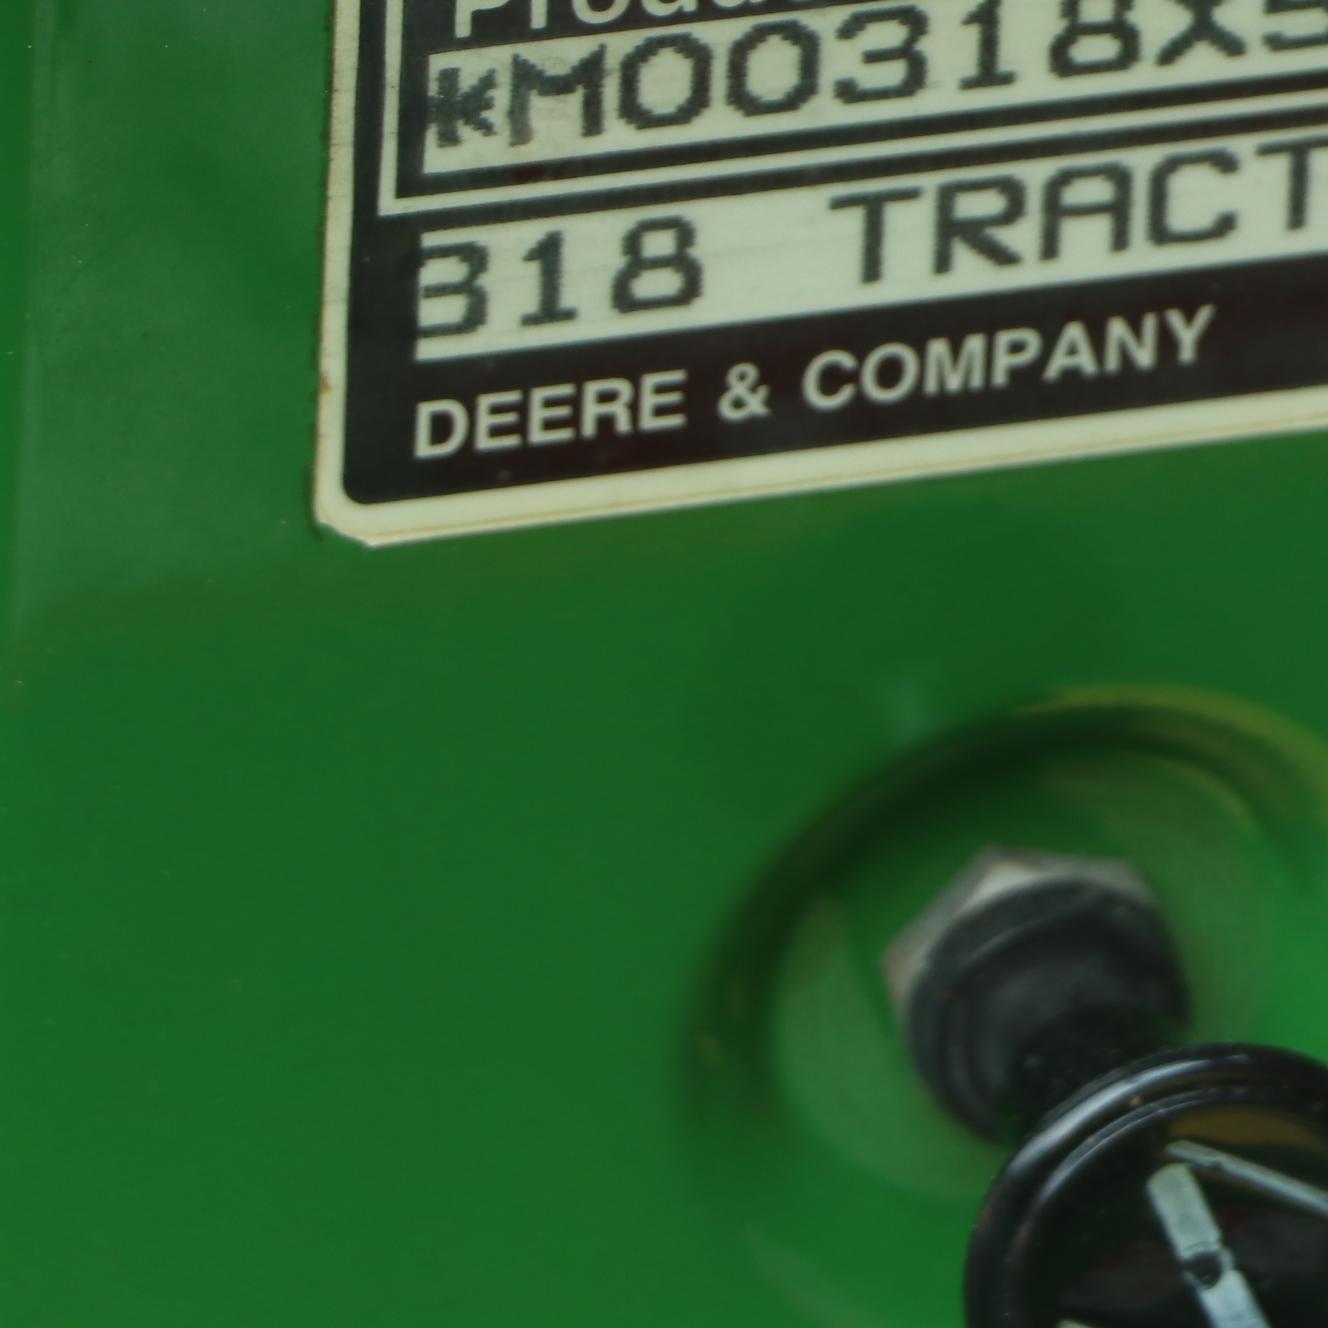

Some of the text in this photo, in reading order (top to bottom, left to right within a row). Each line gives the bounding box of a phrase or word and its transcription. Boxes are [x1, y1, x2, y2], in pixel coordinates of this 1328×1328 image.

[416, 215, 704, 339] 318
[415, 370, 689, 459] DEERE
[717, 364, 770, 422] &
[803, 306, 1216, 412] COMPANY
